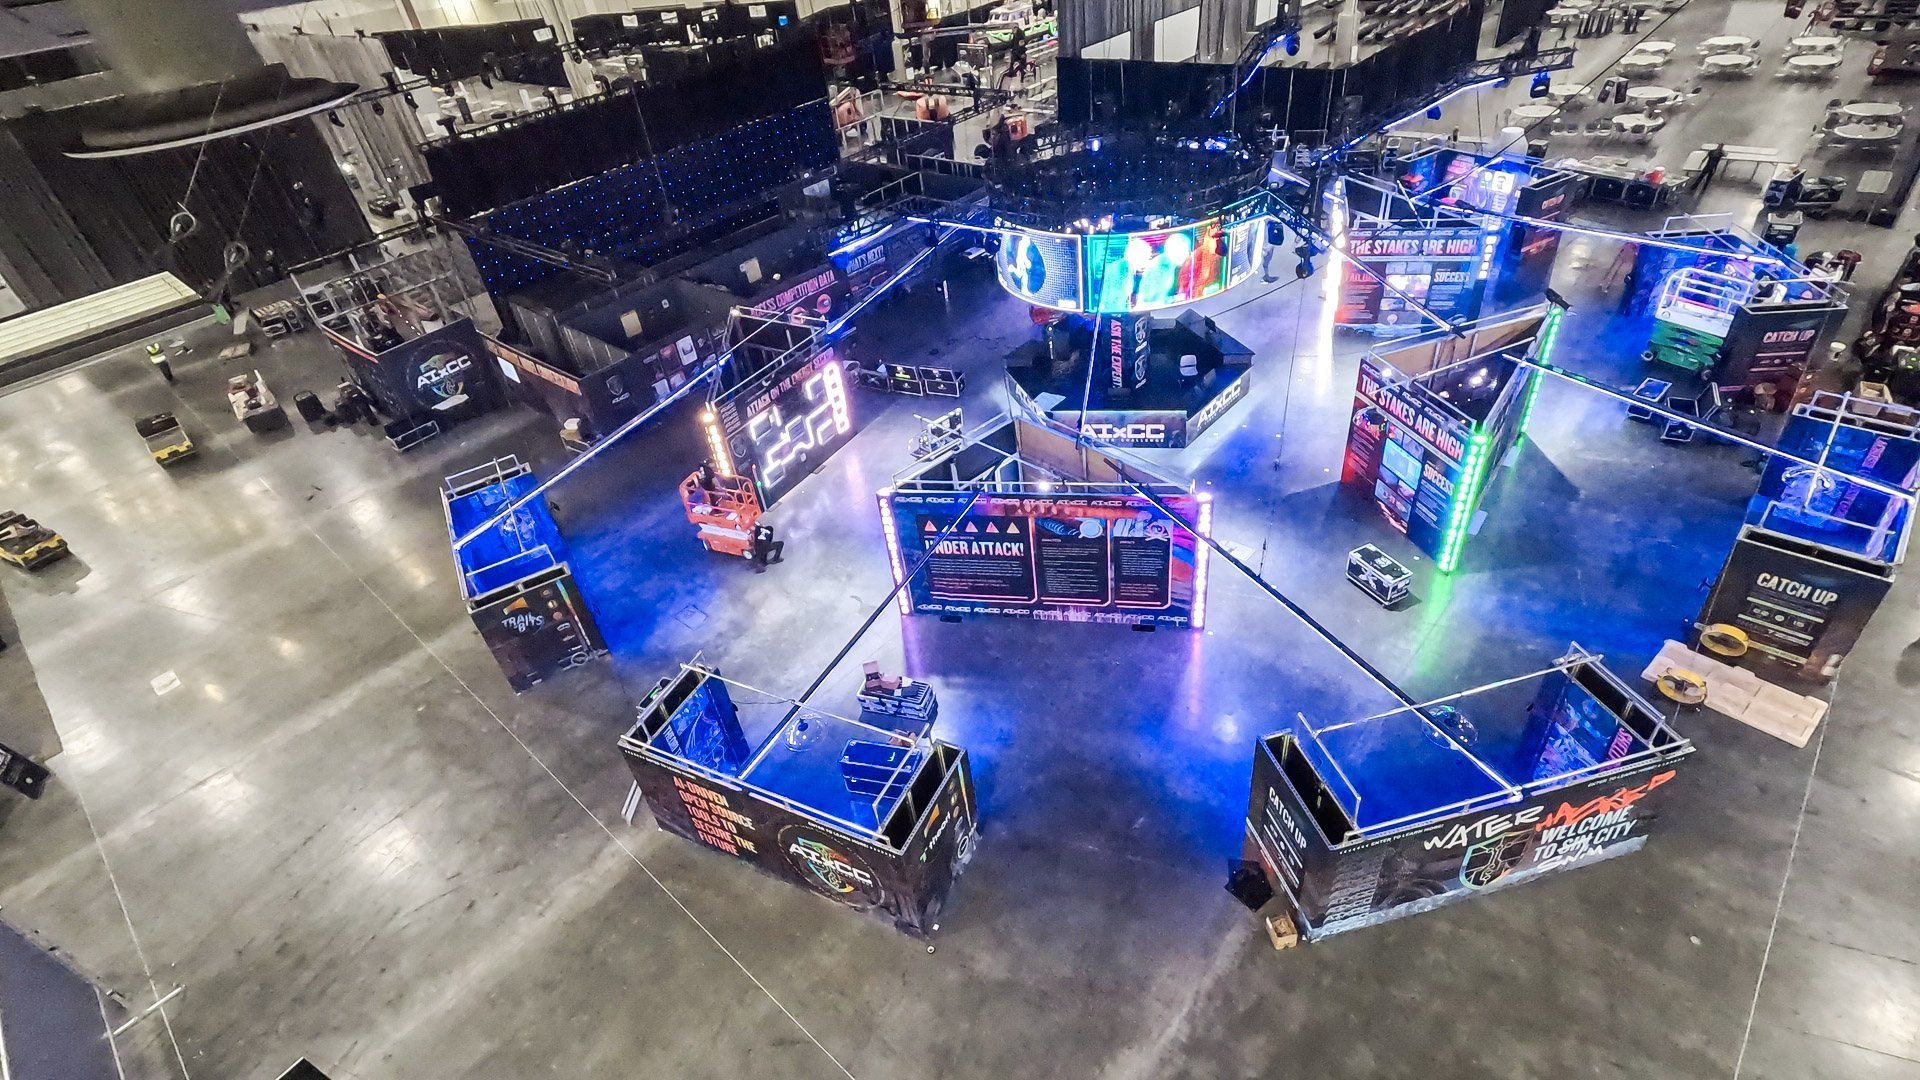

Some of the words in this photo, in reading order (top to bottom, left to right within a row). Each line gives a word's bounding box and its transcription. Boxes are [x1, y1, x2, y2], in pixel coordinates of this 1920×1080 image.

[1350, 240, 1372, 255] THE
[1373, 240, 1420, 255] STAKES
[1423, 240, 1446, 255] ARE
[1447, 239, 1477, 254] HIGH
[776, 277, 820, 307] COMPETITION
[819, 269, 835, 288] DATA
[1434, 272, 1470, 282] SUCCESS
[1110, 319, 1122, 337] ASK
[1763, 331, 1800, 344] CATCH
[1799, 329, 1816, 341] UP
[1111, 338, 1122, 355] THE
[417, 355, 472, 389] AIxCC
[1111, 355, 1123, 388] EXPERT
[746, 392, 771, 418] ATTACK
[770, 385, 780, 401] ON
[779, 377, 792, 393] THE
[1197, 377, 1242, 428] AIxCC
[1081, 423, 1166, 439] AIxCC
[1361, 374, 1380, 401] THE
[1378, 390, 1416, 427] STAKES
[1414, 413, 1437, 442] ARE
[1435, 427, 1465, 462] HIGH
[1423, 463, 1455, 496] SUCCESS
[972, 541, 1024, 556] ATTACK!
[1756, 572, 1811, 599] CATCH
[1811, 589, 1838, 606] UP
[673, 776, 729, 808] AI-DRIVEN
[679, 789, 710, 810] OPEN
[708, 802, 756, 831] SOURCE
[684, 803, 721, 827] TOOLS
[720, 818, 737, 834] TO
[1268, 786, 1294, 834] CATCH
[1294, 827, 1307, 849] UP
[1541, 805, 1634, 845] WELCOME
[691, 817, 735, 844] SECURE
[733, 834, 758, 854] THE
[698, 830, 740, 857] FUTURE
[1424, 805, 1545, 850] WATER
[1533, 843, 1558, 862] TO
[1593, 819, 1638, 845] CITY
[789, 843, 874, 888] AIxCC
